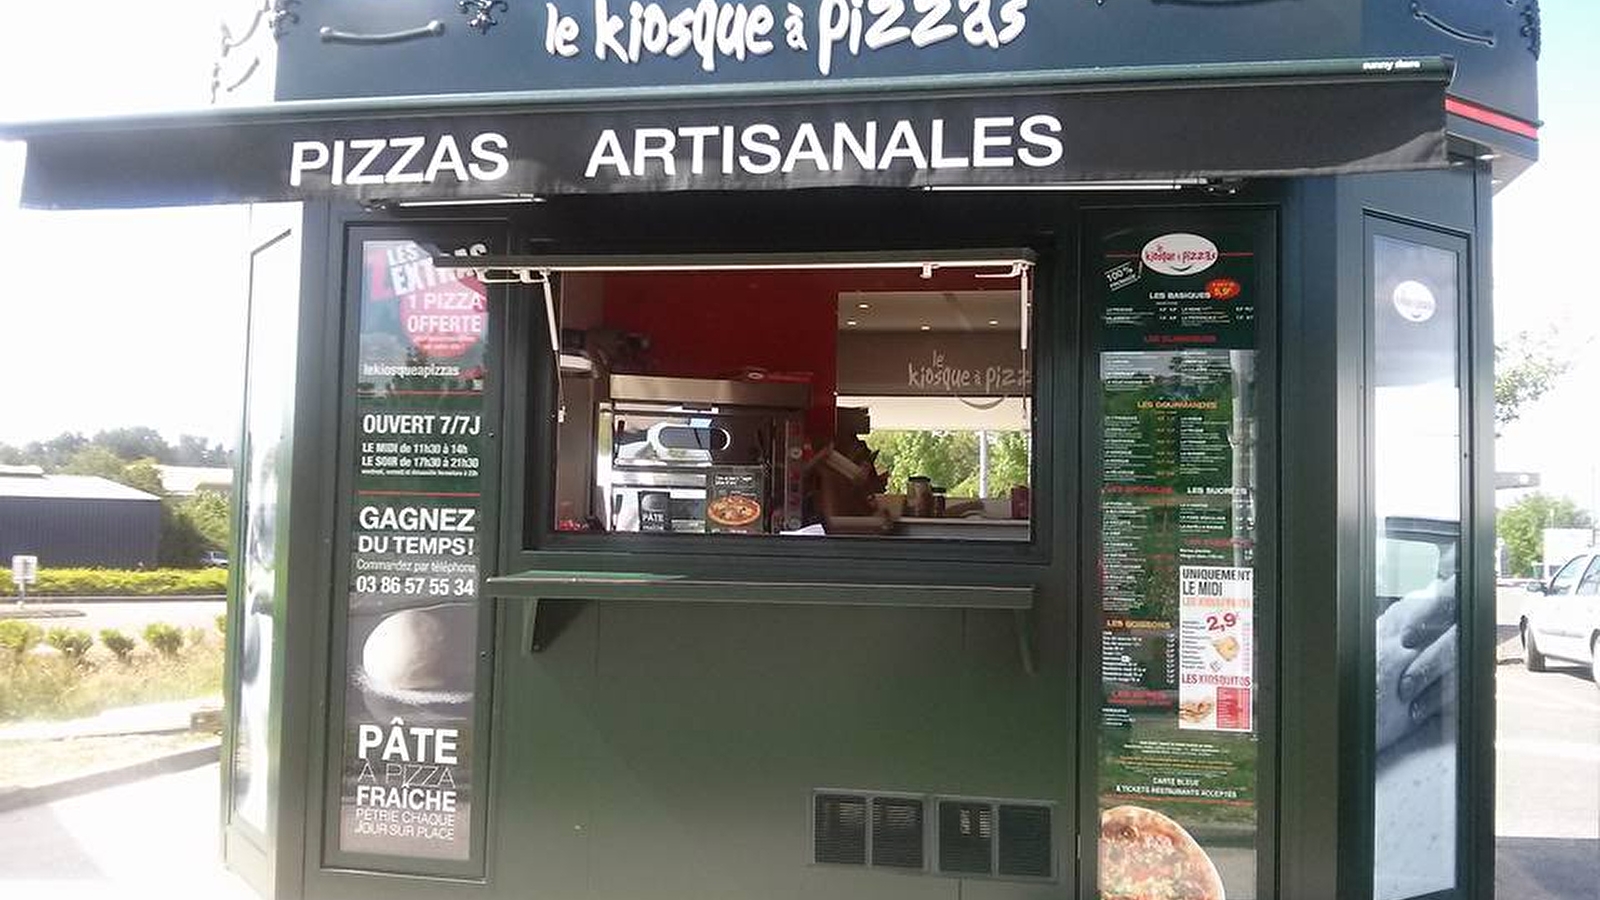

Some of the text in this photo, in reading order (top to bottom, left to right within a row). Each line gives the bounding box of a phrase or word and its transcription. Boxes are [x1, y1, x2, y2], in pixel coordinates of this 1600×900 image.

[545, 0, 1027, 75] le kiosque à pizzas
[290, 114, 1064, 186] PIZZAS ARTISANALES
[424, 292, 484, 310] PIZZA
[408, 314, 481, 333] OFFERTE
[932, 350, 944, 367] le
[908, 362, 971, 391] kiosque
[1136, 401, 1154, 409] LES
[363, 414, 481, 435] OUVERT 7/7J
[362, 442, 375, 453] LE
[362, 456, 374, 466] LE
[375, 456, 398, 467] SOIR
[413, 457, 441, 468] 17h30
[1187, 486, 1204, 494] LES
[359, 506, 476, 532] GAGNEZ
[358, 535, 388, 552] DU
[356, 558, 412, 571] Commandez
[414, 561, 430, 573] par
[1182, 568, 1251, 581] UNIQUEMENT
[356, 575, 475, 596] 03 86 57 55 34
[1183, 581, 1222, 596] LE MIDI
[1182, 673, 1198, 684] LES
[358, 716, 458, 765] PÂTE
[386, 763, 457, 789] PIZZA
[356, 783, 457, 812] FRAÎCHE
[402, 811, 455, 827] CHAQUE
[354, 820, 455, 841] JOUR SUR PLACE
